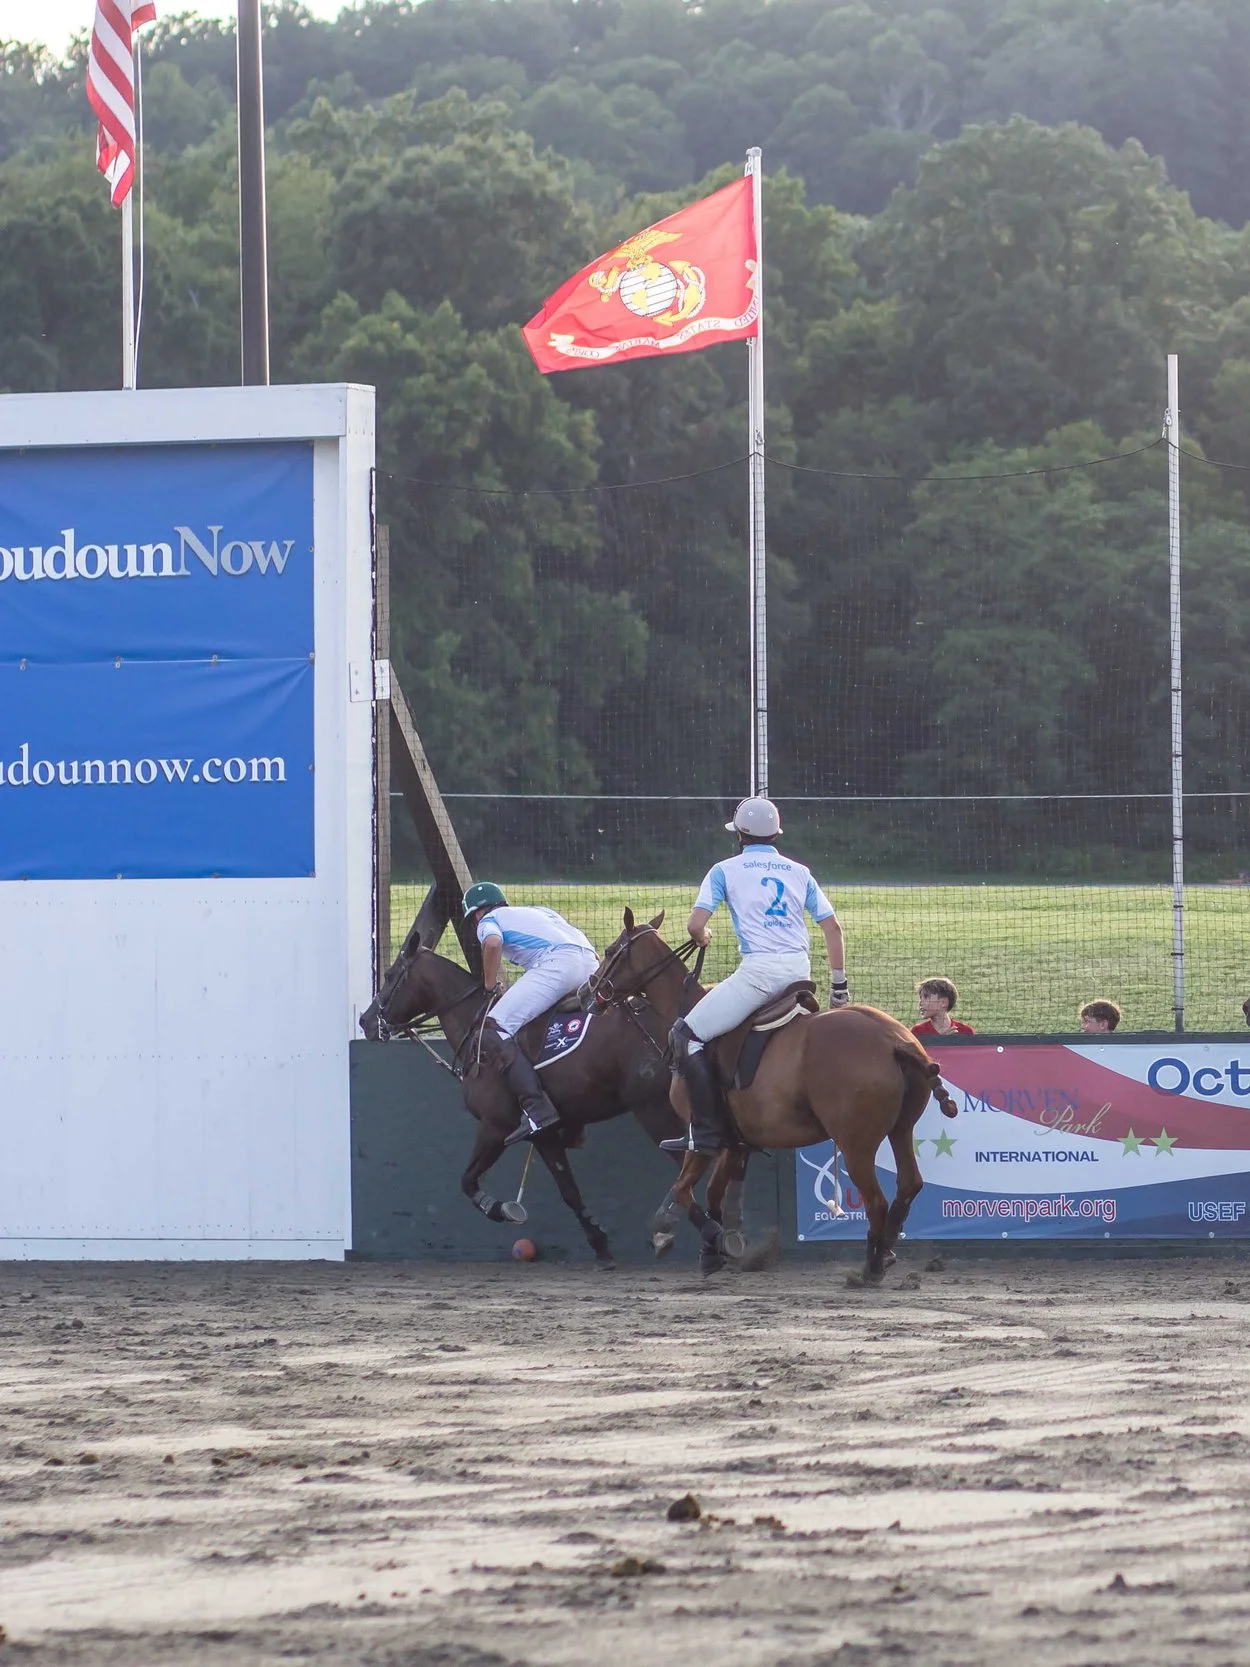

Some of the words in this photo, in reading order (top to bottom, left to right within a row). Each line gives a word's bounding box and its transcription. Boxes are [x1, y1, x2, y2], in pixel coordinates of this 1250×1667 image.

[742, 860, 792, 871] salesforce
[760, 877, 787, 916] 2
[962, 1087, 1080, 1113] MORVEN
[1034, 1102, 1112, 1136] Park
[974, 1151, 1099, 1163] INTERNATIONAL
[846, 1187, 865, 1210] U
[942, 1194, 1117, 1222] morvenpark.org
[814, 1211, 868, 1221] EQUSTRI
[1188, 1201, 1246, 1222] USEF
